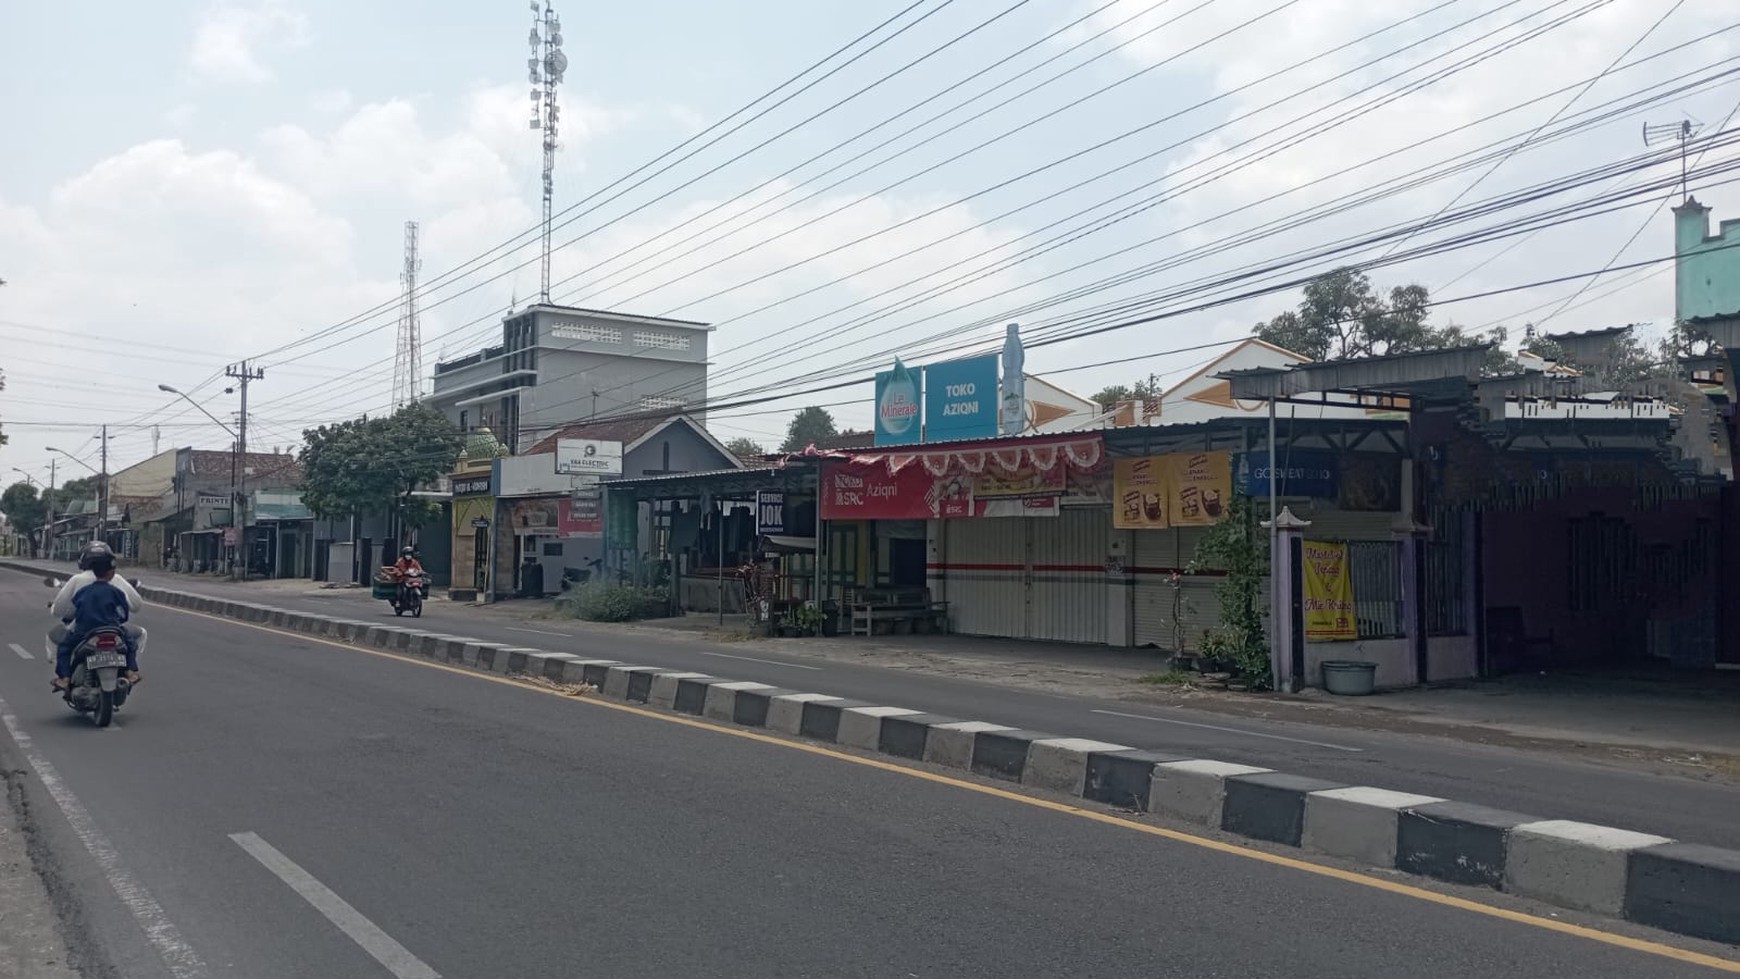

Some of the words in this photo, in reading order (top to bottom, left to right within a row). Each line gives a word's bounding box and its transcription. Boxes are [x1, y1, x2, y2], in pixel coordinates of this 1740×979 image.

[945, 382, 976, 398] TOKO
[892, 391, 904, 406] Le
[880, 401, 919, 418] Minerale
[942, 402, 979, 417] AZIQNI
[760, 493, 783, 504] SERVICE
[843, 491, 864, 506] SRC
[866, 481, 898, 501] Aziqni
[760, 504, 783, 526] JOK
